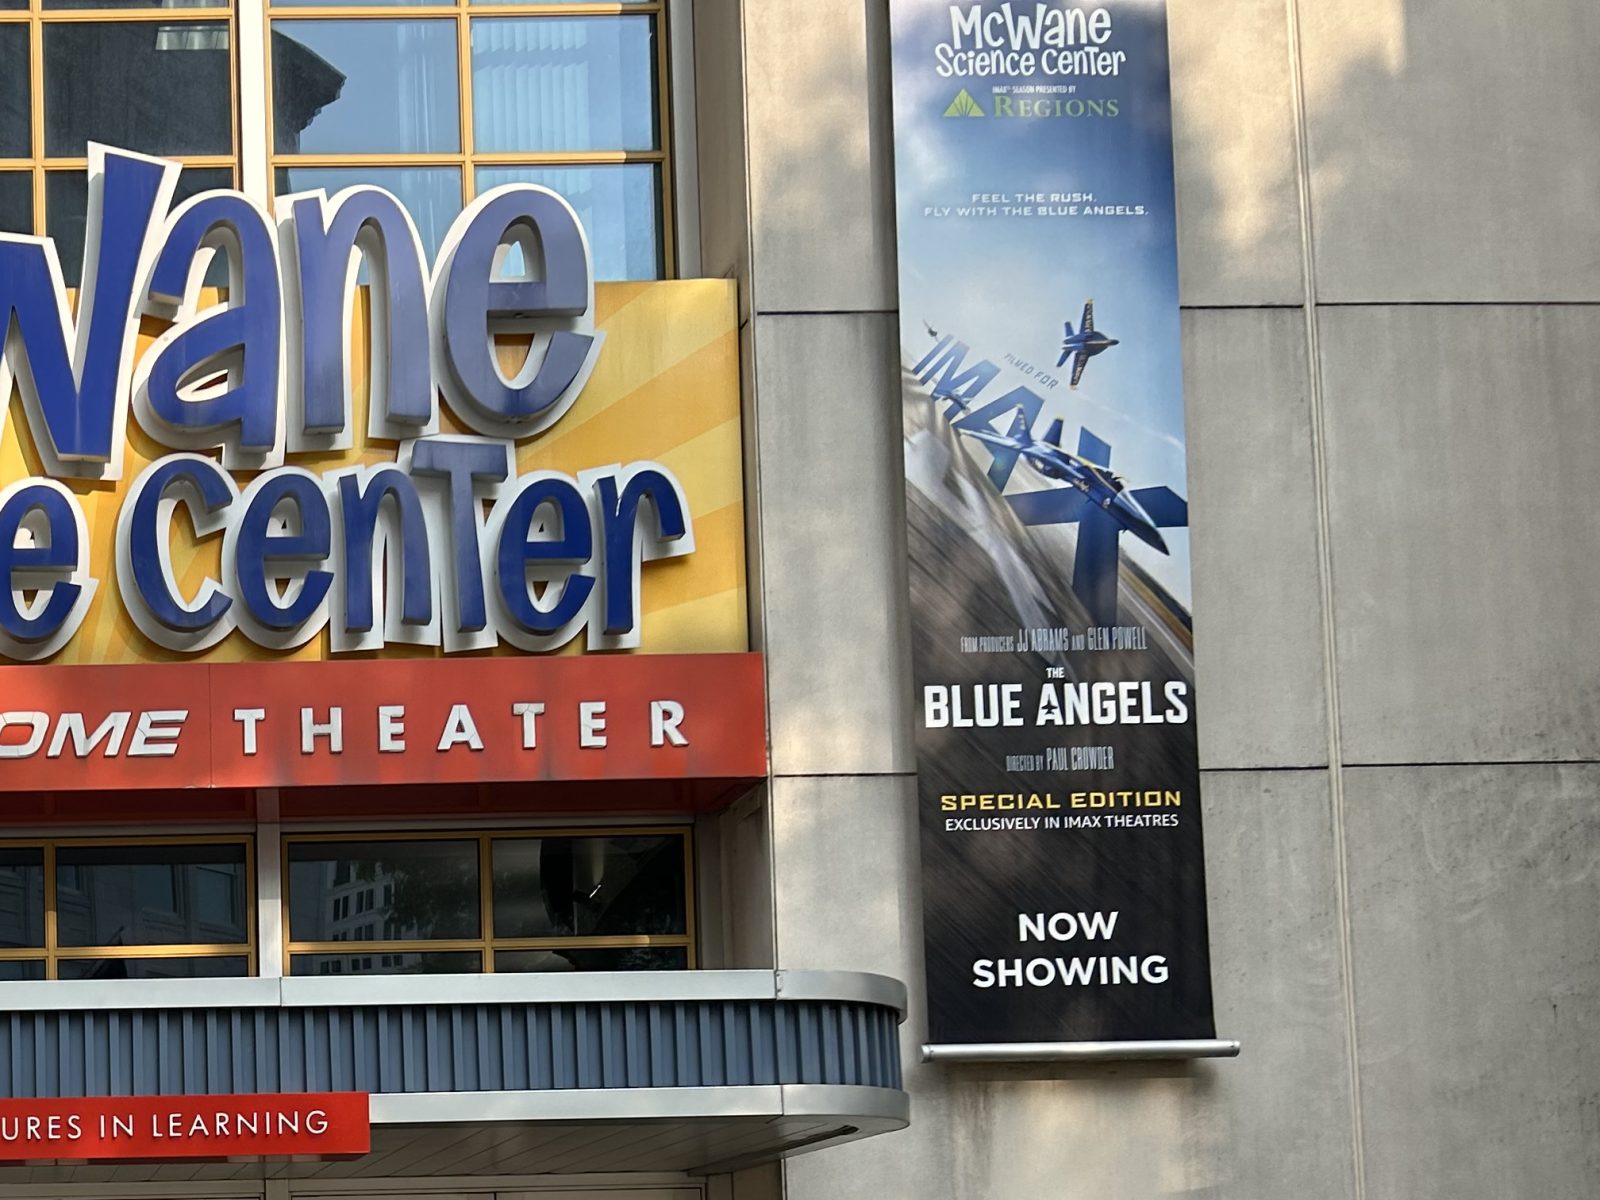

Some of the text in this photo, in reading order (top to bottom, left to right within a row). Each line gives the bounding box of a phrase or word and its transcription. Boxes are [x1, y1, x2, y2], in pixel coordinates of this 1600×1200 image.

[950, 3, 1113, 51] McWane
[935, 43, 1127, 78] Science Center
[924, 207, 951, 217] FLY
[956, 207, 997, 217] WITH
[1002, 206, 1032, 216] THE
[1037, 206, 1078, 216] BLUE
[972, 194, 1011, 203] FEEL
[1015, 194, 1046, 203] THE
[1034, 371, 1059, 389] FOR
[116, 435, 697, 653] Center
[960, 635, 978, 653] FROM
[979, 635, 1014, 652] PRODUCERS
[1031, 628, 1069, 651] ABRAMS
[1072, 635, 1085, 651] AND
[1087, 627, 1110, 651] GLEN
[1112, 626, 1148, 650] POWELL
[1046, 667, 1065, 679] THE
[923, 681, 1189, 728] BLUE ANGELS
[233, 700, 690, 755] THEATER
[1006, 746, 1115, 772] DIRECTED BY PAUL CROWDER
[941, 790, 1182, 811] SPECIAL EDITION
[945, 814, 1179, 832] EXCLUSIVELY IN IMAX THEATRES
[1018, 911, 1119, 942] NOW
[972, 955, 1169, 988] SHOWING
[100, 1114, 135, 1138] IN
[152, 1110, 330, 1137] LEARNING
